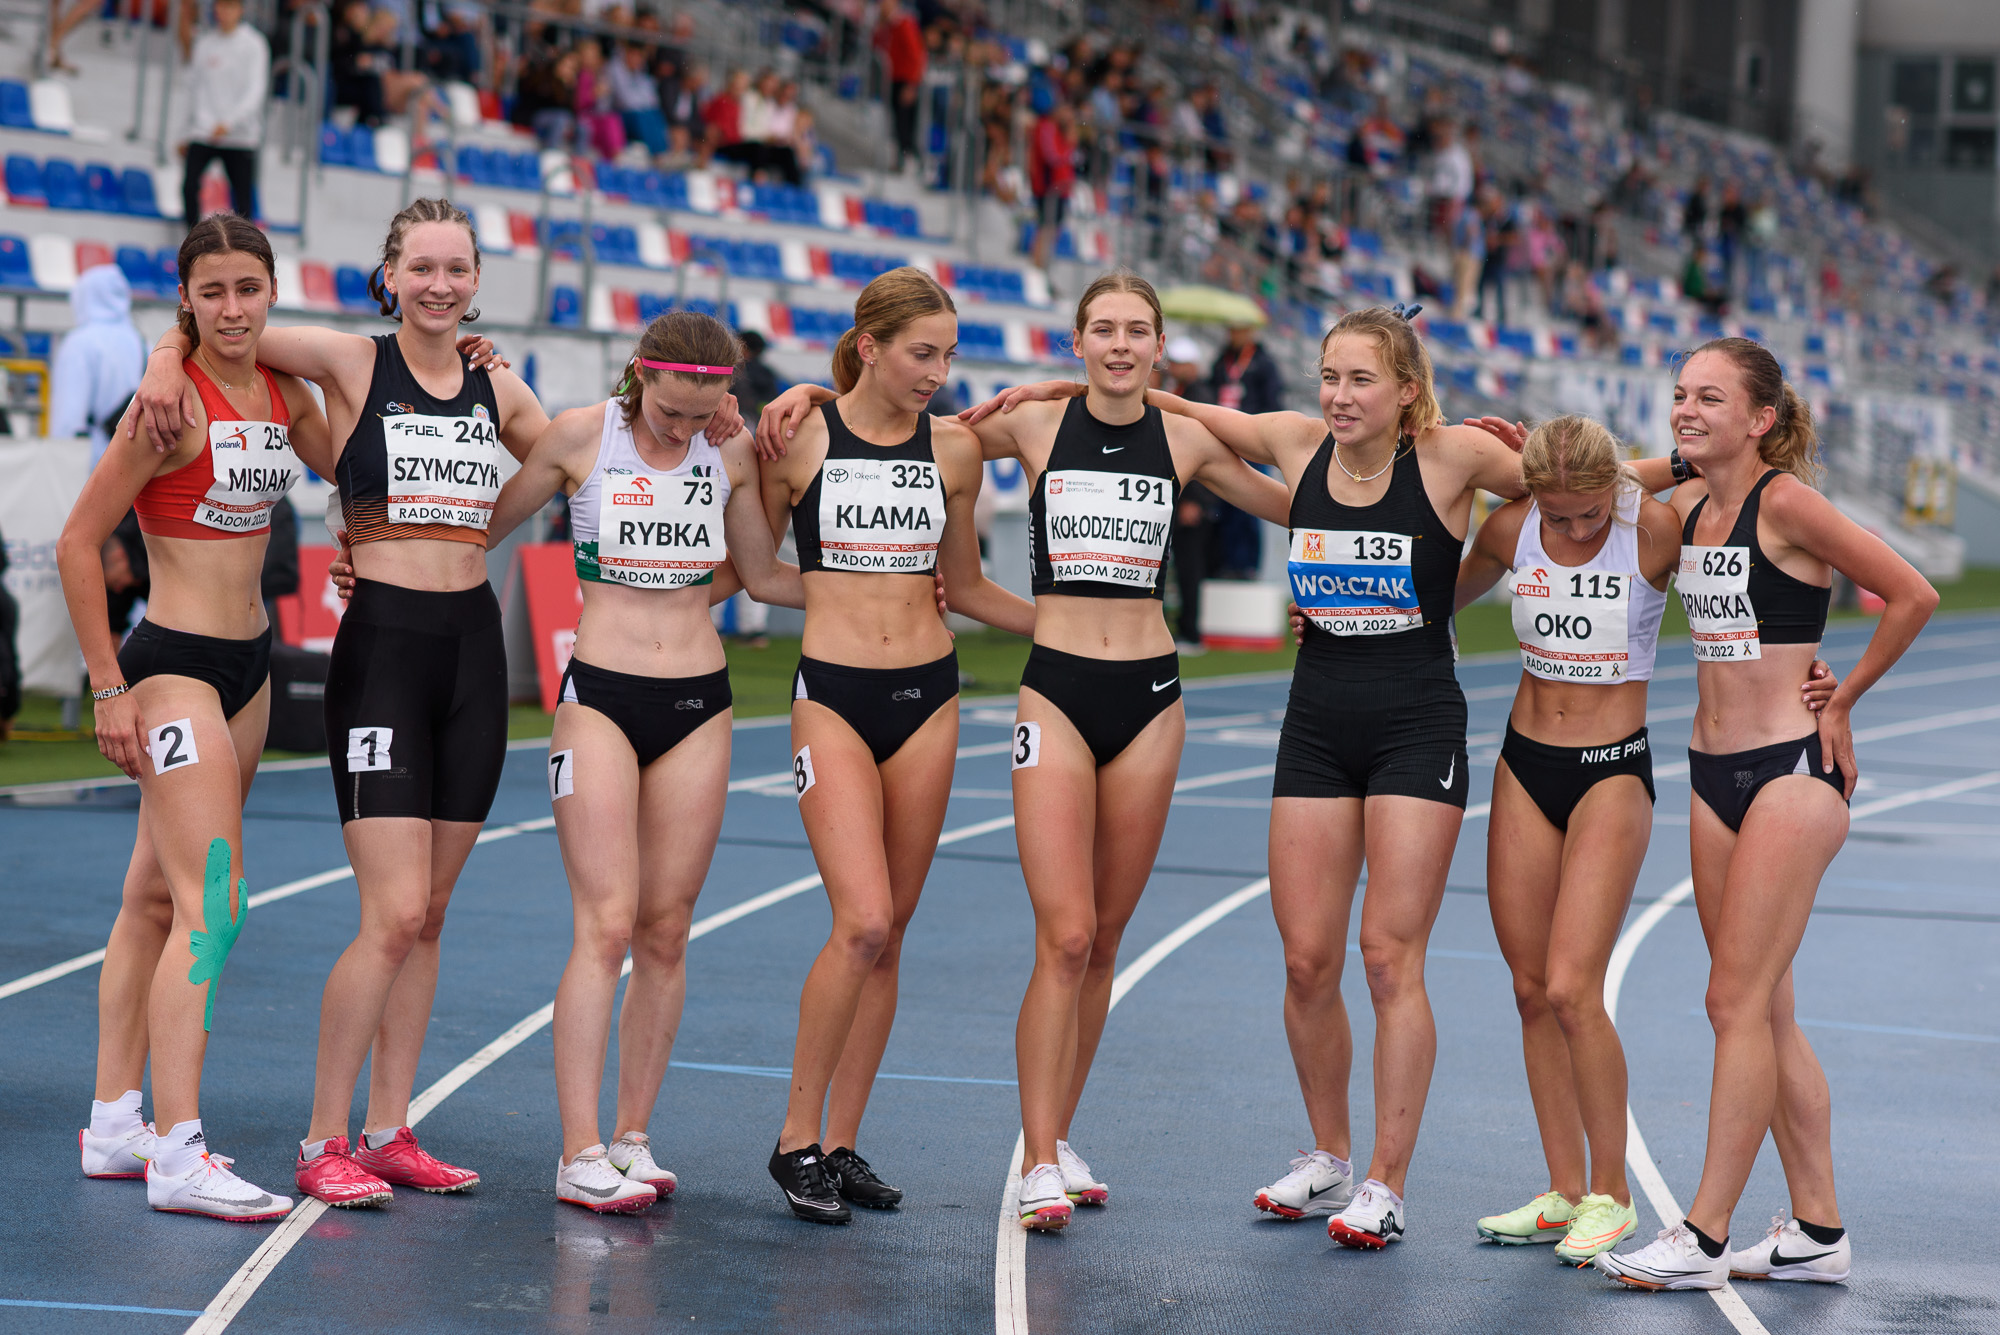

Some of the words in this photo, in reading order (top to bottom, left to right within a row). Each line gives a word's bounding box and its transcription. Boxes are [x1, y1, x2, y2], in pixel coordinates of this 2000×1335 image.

[264, 425, 291, 451] 254
[405, 425, 444, 437] FUEL
[454, 420, 496, 448] 244
[215, 441, 241, 450] polanik
[228, 468, 292, 492] MISIAK
[394, 457, 499, 489] SZYMCZYK
[855, 472, 880, 480] Okęcie
[891, 464, 935, 489] 325
[415, 496, 465, 506] MISTRZOSTWA
[615, 495, 651, 505] ORLEN
[683, 481, 713, 506] 73
[1118, 478, 1165, 505] 191
[205, 510, 251, 527] RADOM
[399, 508, 454, 520] RADOM
[457, 511, 480, 523] 2022
[836, 504, 931, 530] KLAMA
[619, 521, 711, 547] RYBKA
[1051, 515, 1166, 547] KOŁODZIEJCZUK
[832, 553, 885, 567] RADOM
[890, 556, 918, 567] 2022
[1070, 553, 1123, 563] MISTRZOSTWA
[1124, 558, 1147, 566] POLSKI
[1353, 536, 1403, 560] 135
[623, 559, 681, 568] MISTRZOSTWA
[1058, 564, 1108, 577] RADOM
[1112, 567, 1140, 581] 2022
[1703, 552, 1742, 576] 626
[610, 569, 665, 584] RADOM
[669, 573, 700, 585] 2022
[1293, 574, 1411, 599] WOŁCZAK
[1570, 574, 1621, 599] 115
[1518, 585, 1548, 596] ORLEN
[1681, 592, 1751, 619] ORNACKA
[1362, 619, 1397, 631] 2022
[1535, 613, 1592, 640] OKO
[1714, 633, 1738, 641] POLSKI
[1710, 645, 1735, 657] 2022
[1526, 656, 1565, 675] RADOM
[1568, 666, 1602, 677] 2022
[159, 725, 188, 768] 2
[360, 730, 377, 766] 1
[1015, 725, 1031, 765] 3
[1581, 746, 1621, 763] NIKE
[1624, 737, 1645, 757] PRO
[551, 754, 565, 795] 7
[795, 755, 807, 794] 8
